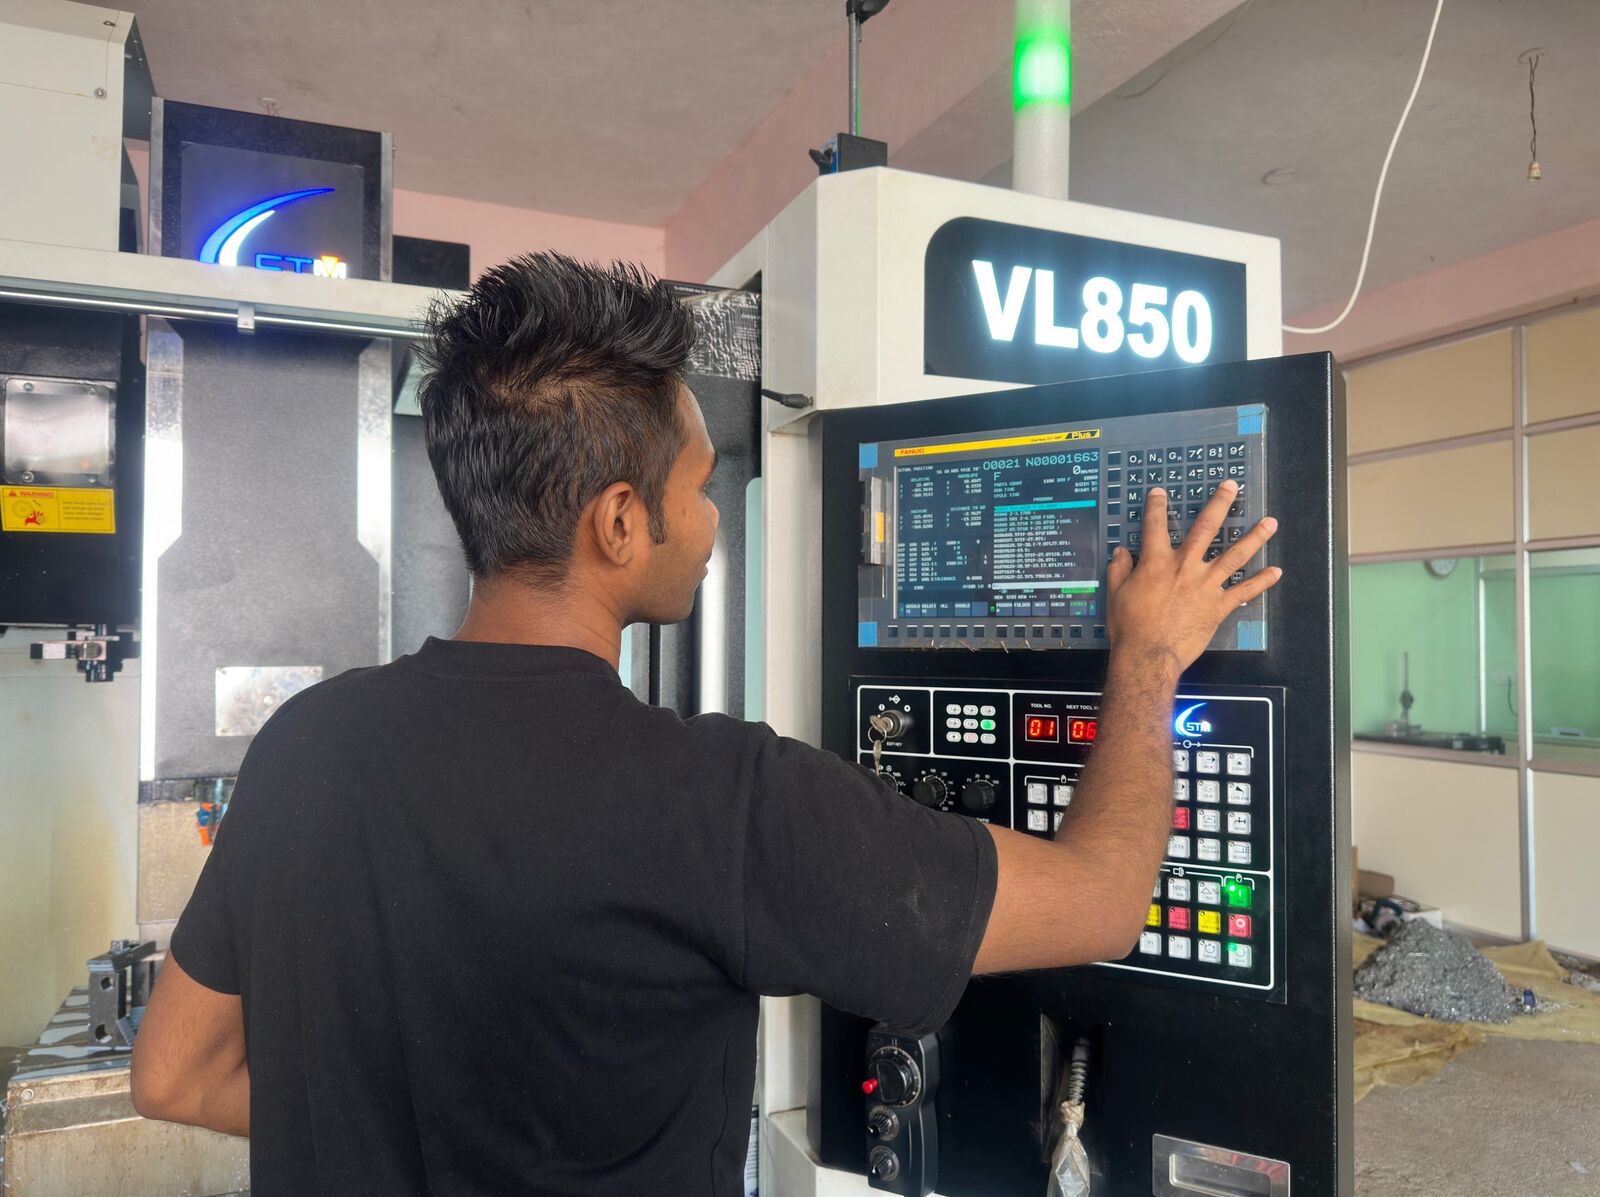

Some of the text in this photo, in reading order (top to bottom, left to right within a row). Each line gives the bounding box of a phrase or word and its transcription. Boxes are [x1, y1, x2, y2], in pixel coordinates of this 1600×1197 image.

[972, 259, 1213, 364] VL850
[1026, 452, 1098, 467] N00001663
[1129, 512, 1135, 520] F
[1030, 720, 1054, 736] 01
[1072, 721, 1097, 740] 06
